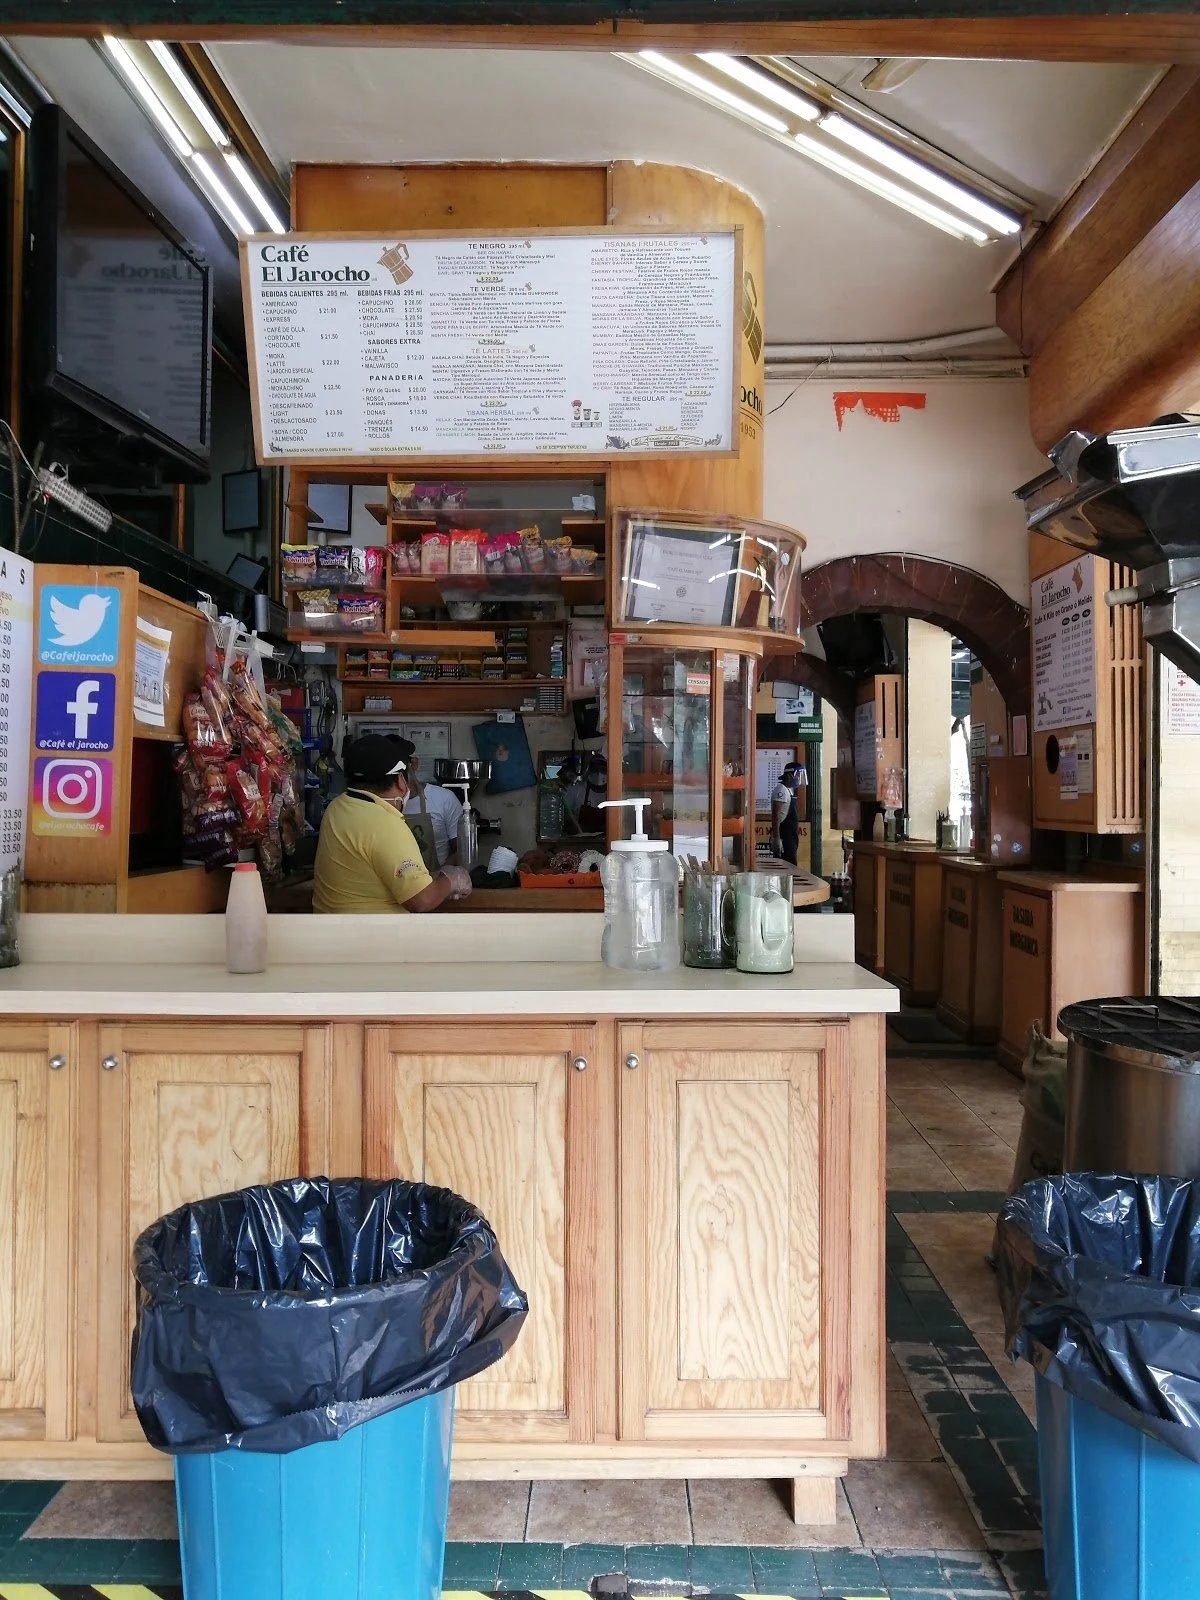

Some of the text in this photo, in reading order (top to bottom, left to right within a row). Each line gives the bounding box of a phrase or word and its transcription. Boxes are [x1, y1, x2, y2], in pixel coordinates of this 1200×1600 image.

[261, 245, 309, 262] Café
[262, 266, 370, 282] El Jarocho
[740, 422, 756, 440] 1953
[1041, 577, 1054, 593] Café
[1048, 586, 1070, 604] Jarocho
[1060, 604, 1074, 614] Grano
[1078, 595, 1092, 606] Molido
[41, 651, 114, 662] @Cafeljarocho
[40, 739, 108, 750] @Café el jarocho
